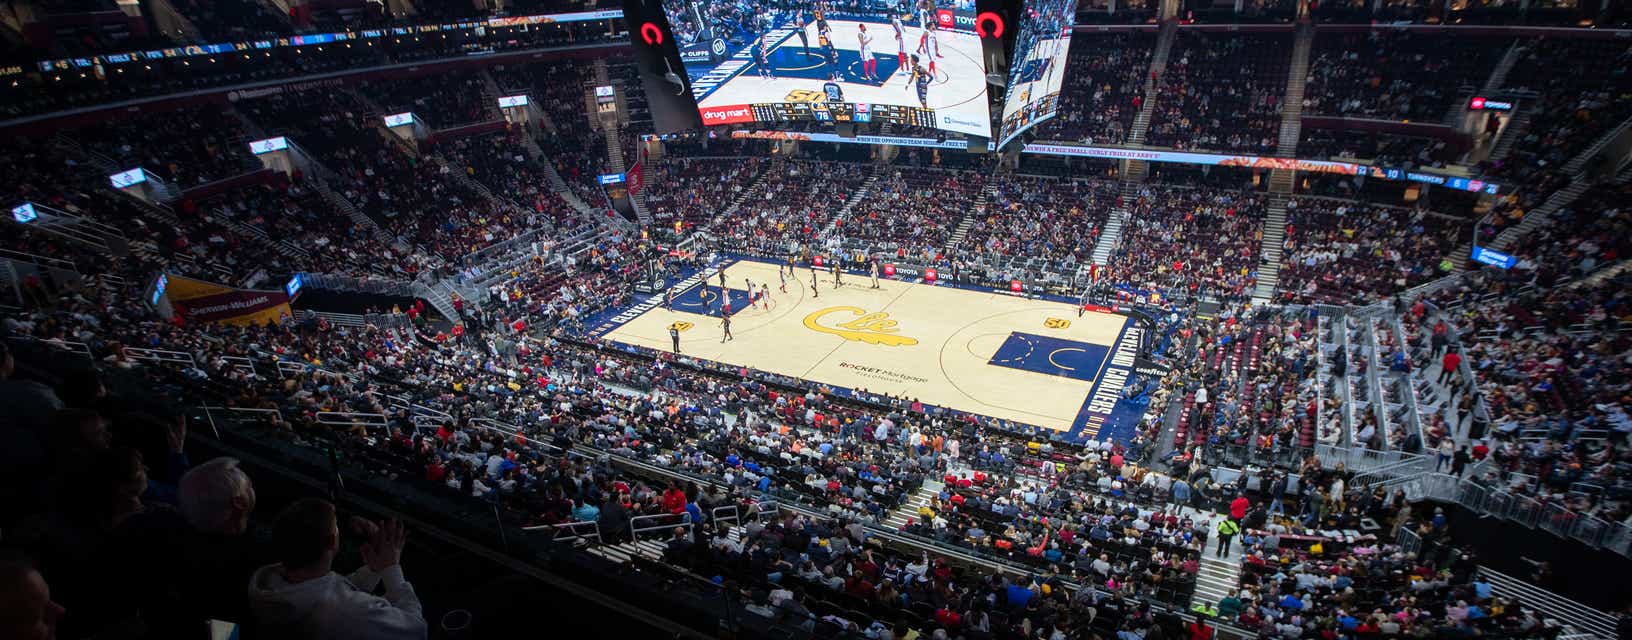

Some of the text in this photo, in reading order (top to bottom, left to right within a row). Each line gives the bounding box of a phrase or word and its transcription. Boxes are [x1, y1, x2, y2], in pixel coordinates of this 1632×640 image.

[955, 15, 977, 25] TOYO
[704, 111, 727, 121] drug
[726, 108, 750, 117] mart
[895, 266, 918, 276] TOYOTA
[1111, 327, 1140, 367] CLEVELAND
[840, 361, 881, 374] ROCKET
[1088, 367, 1130, 415] CAVALIERS
